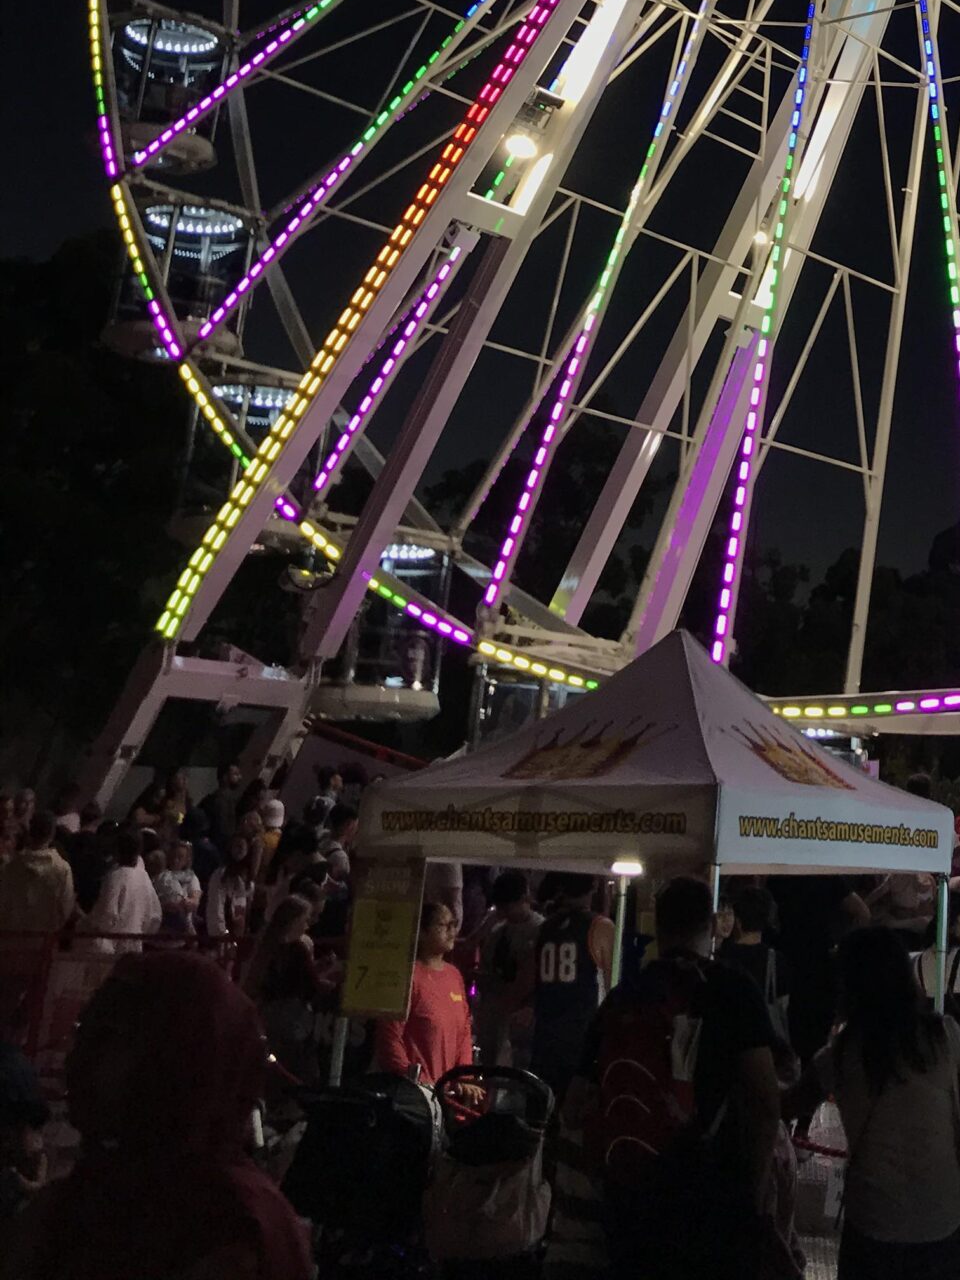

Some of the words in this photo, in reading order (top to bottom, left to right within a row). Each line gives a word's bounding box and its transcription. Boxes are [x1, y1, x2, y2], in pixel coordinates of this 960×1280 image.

[381, 804, 687, 834] www.chantsamusements.com
[738, 812, 939, 849] www.chantsamusements.com
[540, 942, 577, 982] 08
